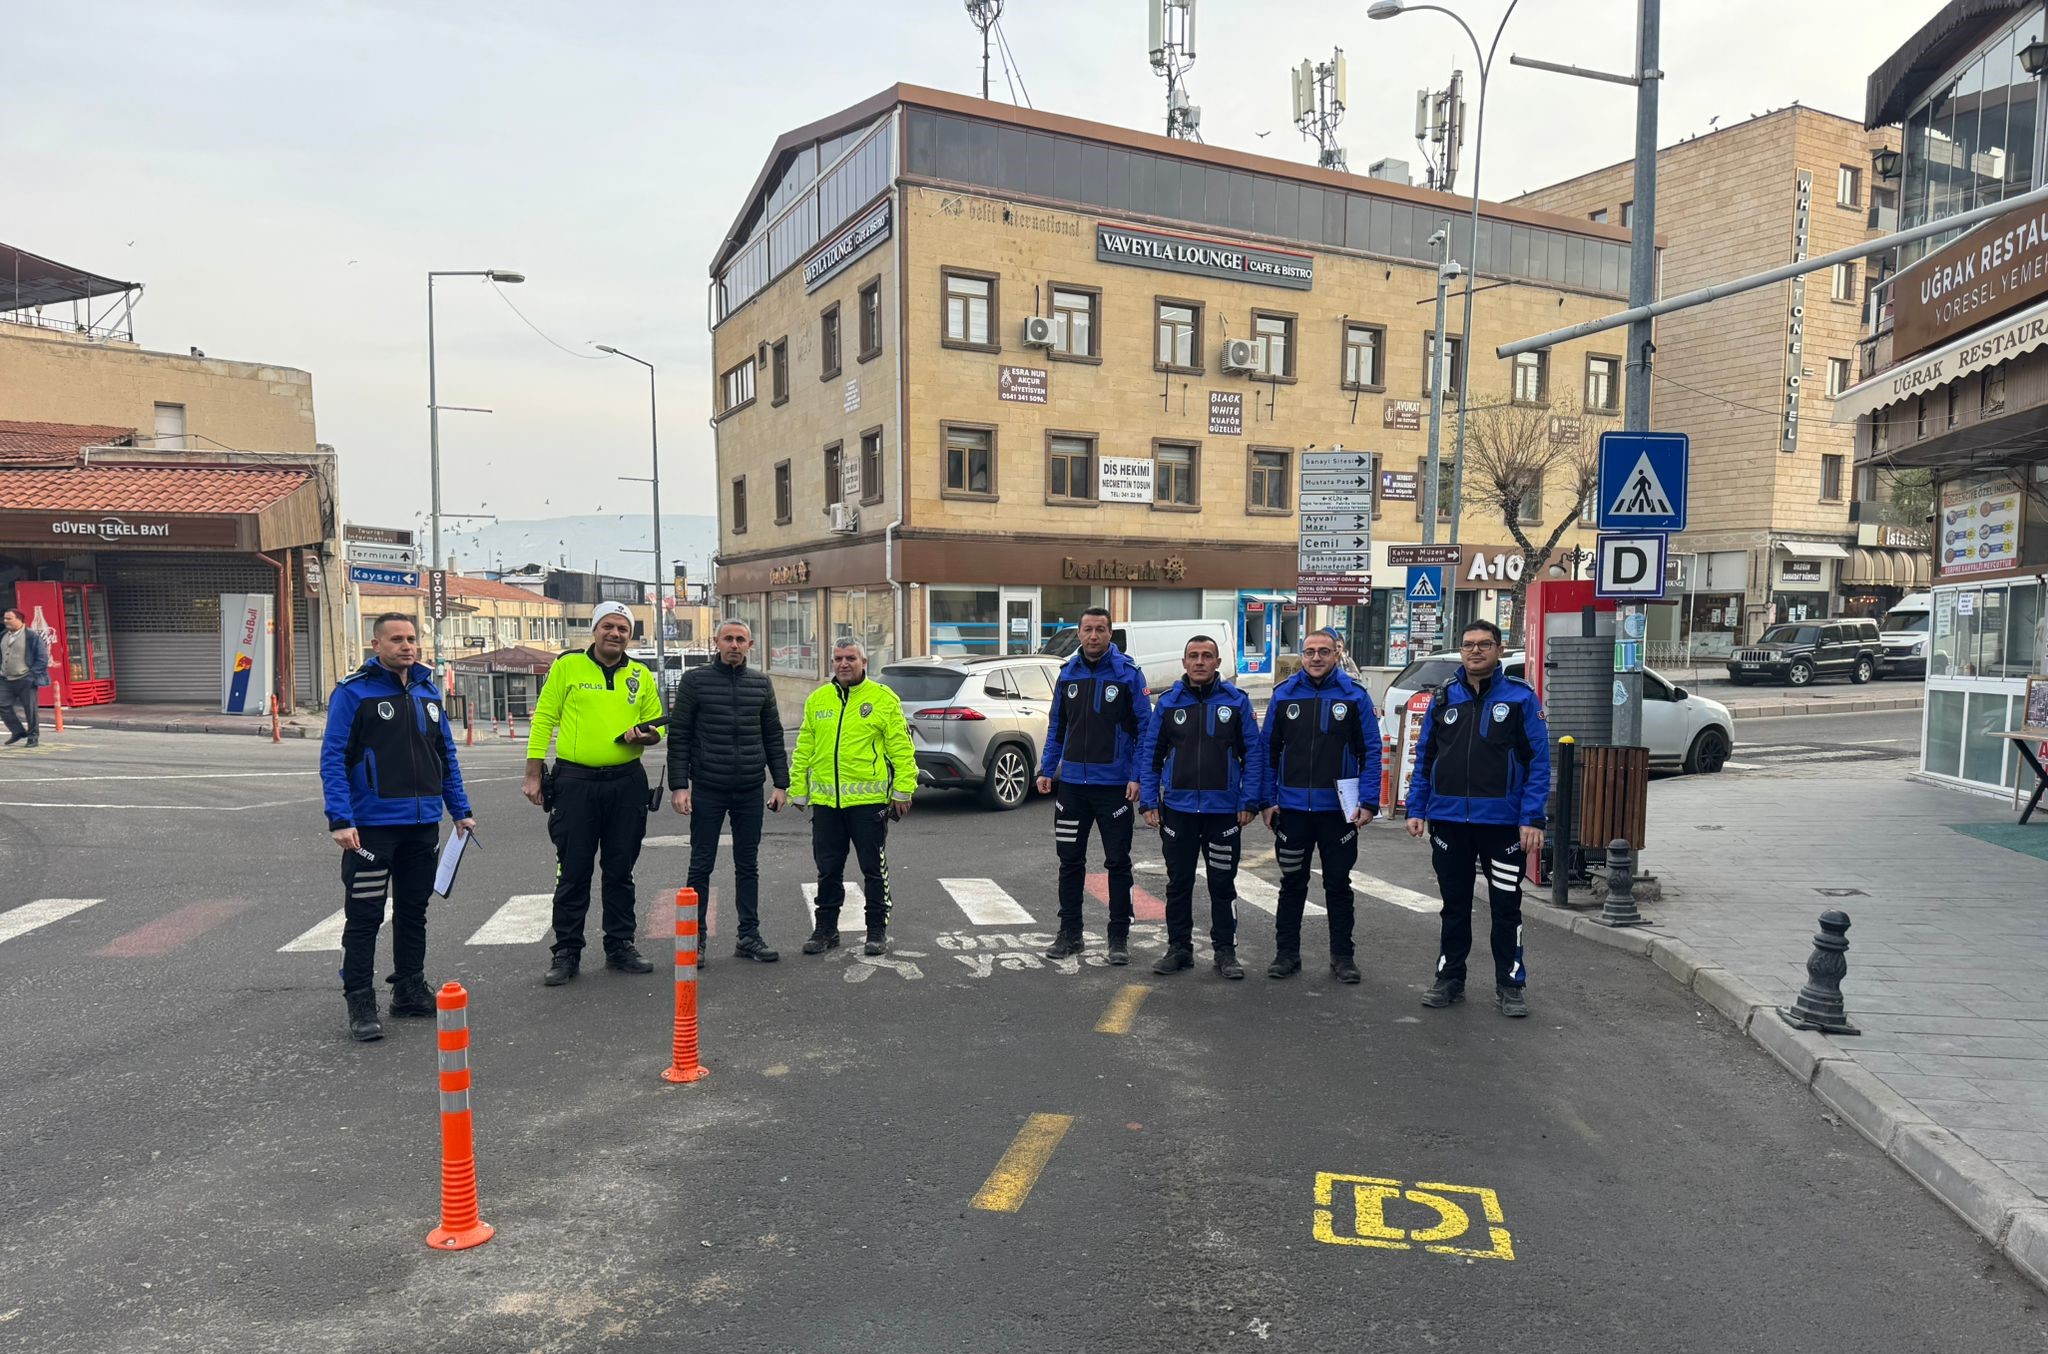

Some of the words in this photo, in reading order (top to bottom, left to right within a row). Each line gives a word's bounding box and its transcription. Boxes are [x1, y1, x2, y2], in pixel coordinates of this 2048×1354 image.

[827, 233, 854, 267] LOUNGE
[1103, 233, 1174, 260] VAVEYLA
[1177, 247, 1242, 271] LOUNGE
[1250, 260, 1273, 274] CAFE
[1273, 265, 1281, 275] &
[1282, 263, 1313, 279] BİSTRO
[1921, 252, 1976, 305] UĞRAK
[1011, 368, 1030, 376] ESRA
[1030, 370, 1046, 378] NUR
[1893, 360, 1945, 395] UĞRAK
[1010, 384, 1046, 395] DİYETİSYEN
[1211, 393, 1240, 403] BLACK
[1211, 406, 1240, 415] WHITE
[1396, 401, 1420, 412] AVUKAT
[1787, 375, 1800, 439] OTEL
[1211, 416, 1240, 425] KUAFÖR
[1209, 424, 1241, 433] GÜZELLİK
[1120, 462, 1150, 477] HEKİMİ
[1102, 477, 1132, 489] NECMETTİN
[1133, 480, 1151, 490] TOSUN
[1305, 515, 1337, 523] Ayvalı
[52, 520, 96, 534] GÜVEN
[98, 523, 139, 536] TEKEL
[140, 523, 169, 536] BAYİ
[347, 534, 393, 543] Information
[1305, 538, 1339, 548] Cemil
[352, 549, 398, 560] Terminal
[1612, 546, 1648, 584] D
[353, 570, 401, 583] Kayseri
[433, 572, 442, 619] OTOPARK
